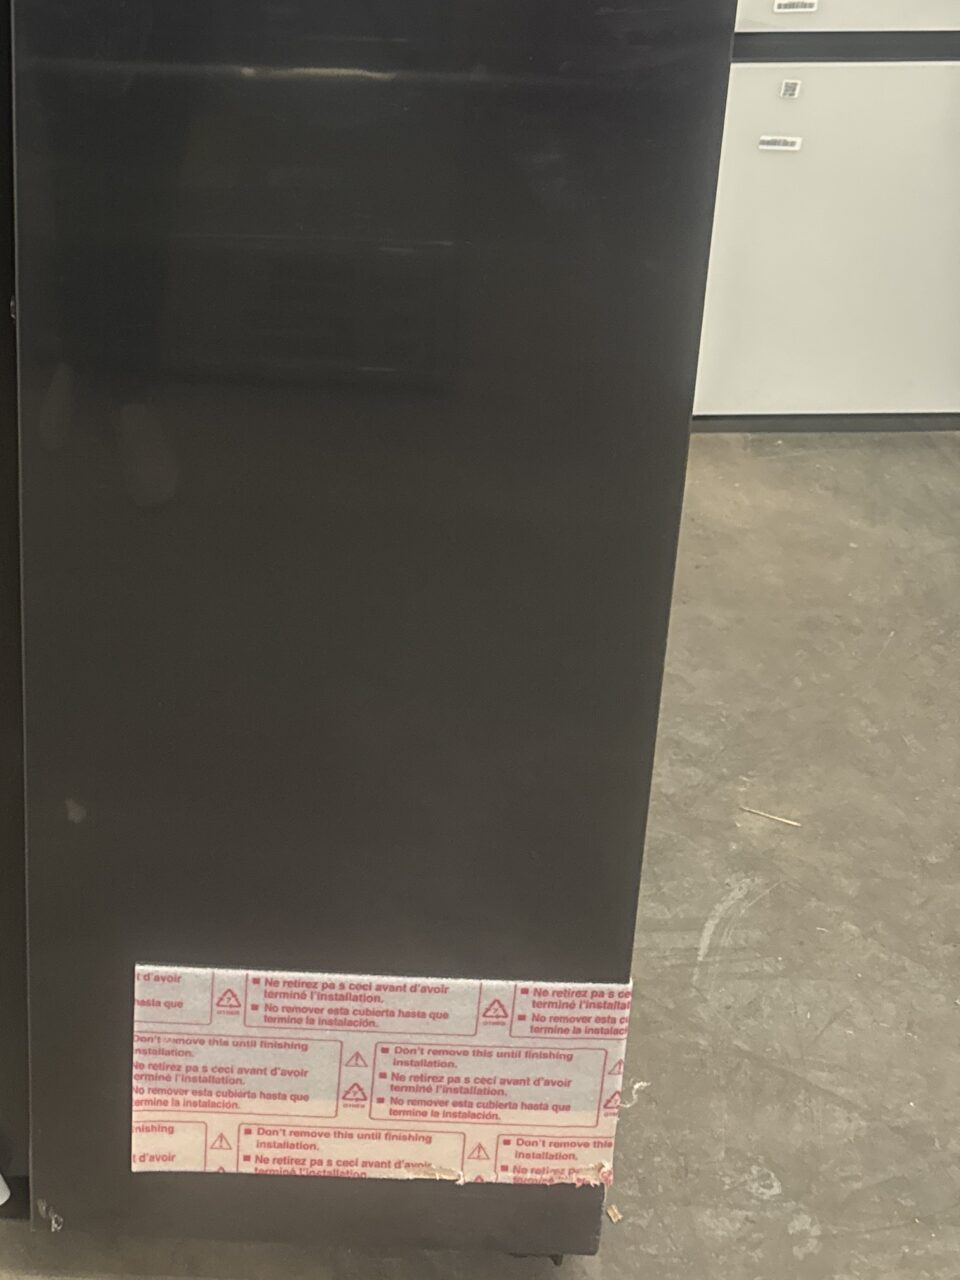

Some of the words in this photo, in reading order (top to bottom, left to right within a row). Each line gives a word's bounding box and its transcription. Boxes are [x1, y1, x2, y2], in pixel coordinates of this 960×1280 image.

[394, 1046, 424, 1055] Don't
[427, 1048, 469, 1056] remove
[471, 1048, 493, 1057] this
[496, 1049, 522, 1058] until
[524, 1050, 573, 1062] finishing
[392, 1058, 458, 1068] installation.
[390, 1073, 406, 1082] Ne
[408, 1073, 444, 1083] retirez
[473, 1075, 496, 1085] ceci
[499, 1076, 530, 1086] avant
[532, 1077, 571, 1087] d'avoir
[389, 1097, 404, 1106] No
[406, 1098, 449, 1107] remover
[451, 1099, 474, 1108] esta
[475, 1100, 518, 1109] cubierta
[520, 1101, 549, 1110] hasta
[551, 1103, 571, 1113] que
[389, 1109, 428, 1117] termine
[430, 1109, 440, 1117] la
